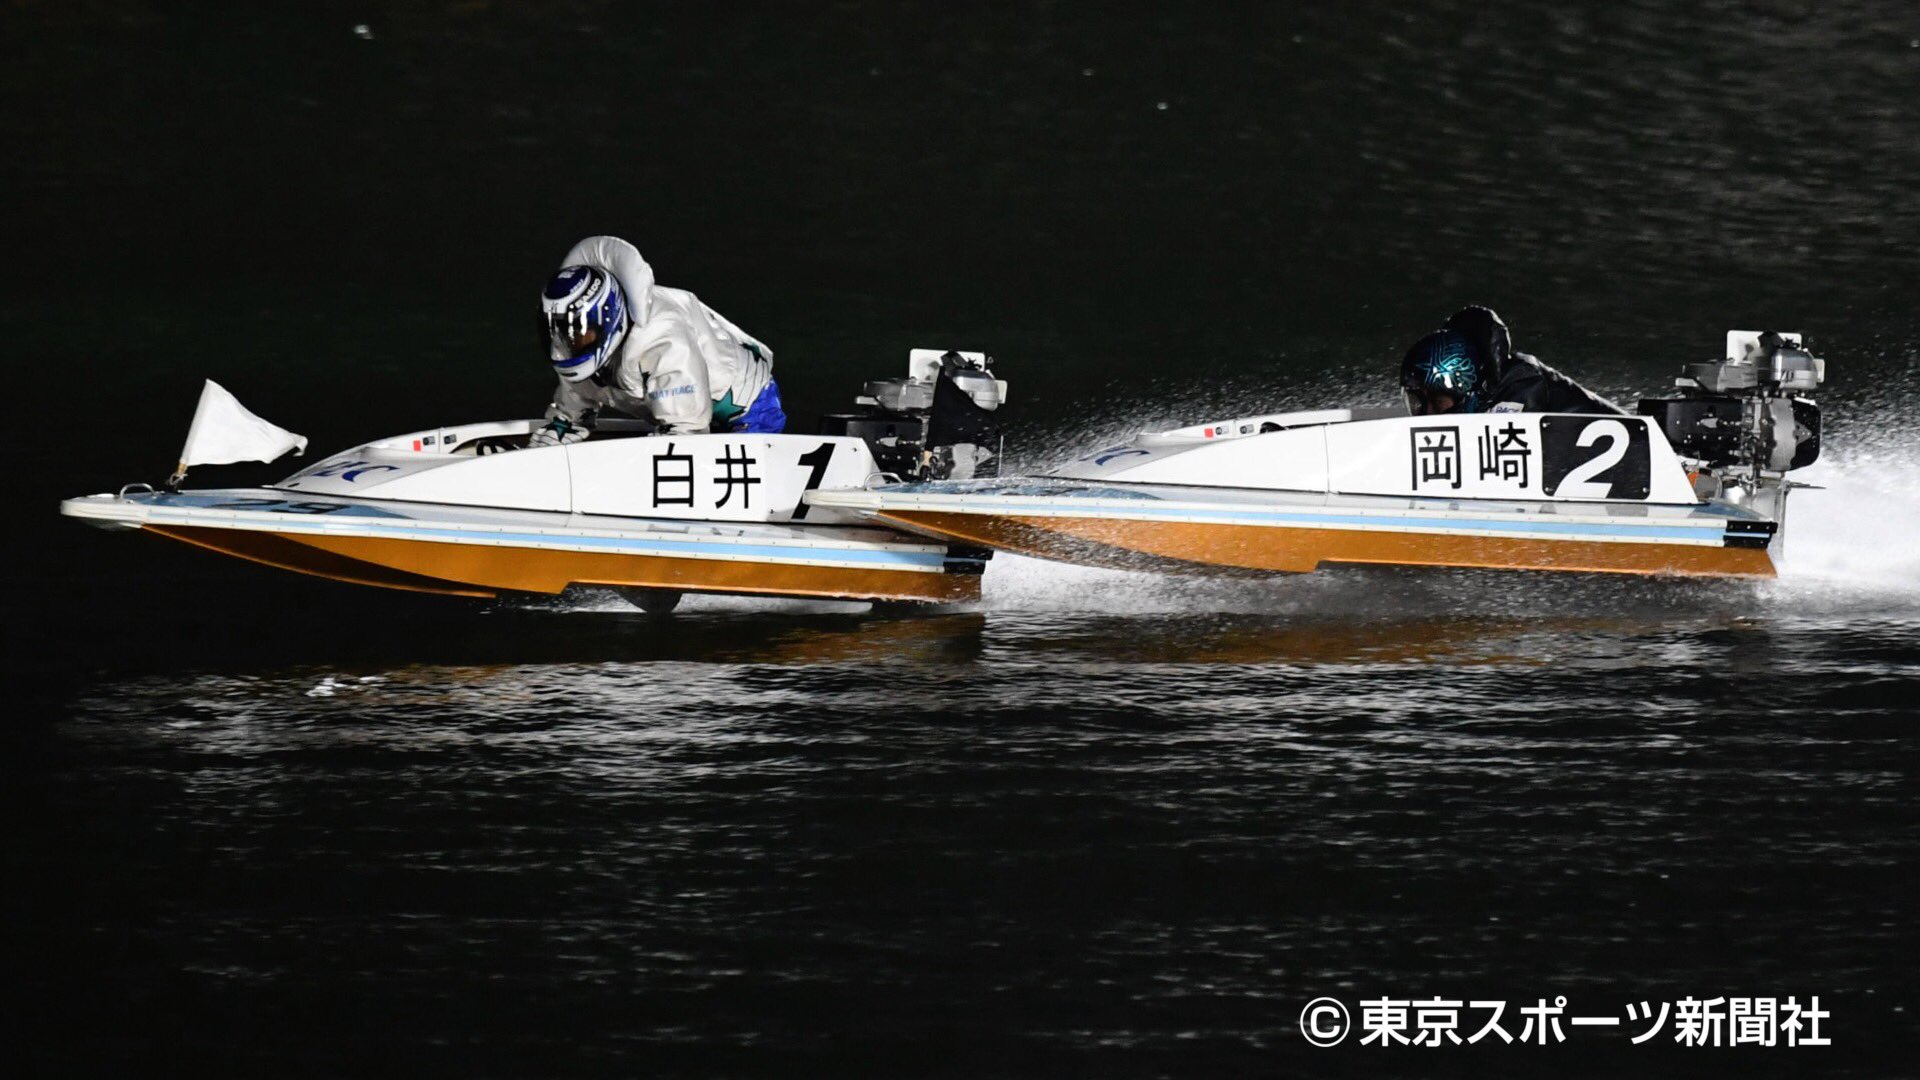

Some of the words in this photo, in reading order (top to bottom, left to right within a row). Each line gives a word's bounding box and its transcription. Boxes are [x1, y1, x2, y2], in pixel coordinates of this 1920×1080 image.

[652, 442, 761, 509] 白井
[791, 442, 836, 519] 1
[1410, 421, 1531, 491] 岡崎
[1555, 418, 1631, 499] 2
